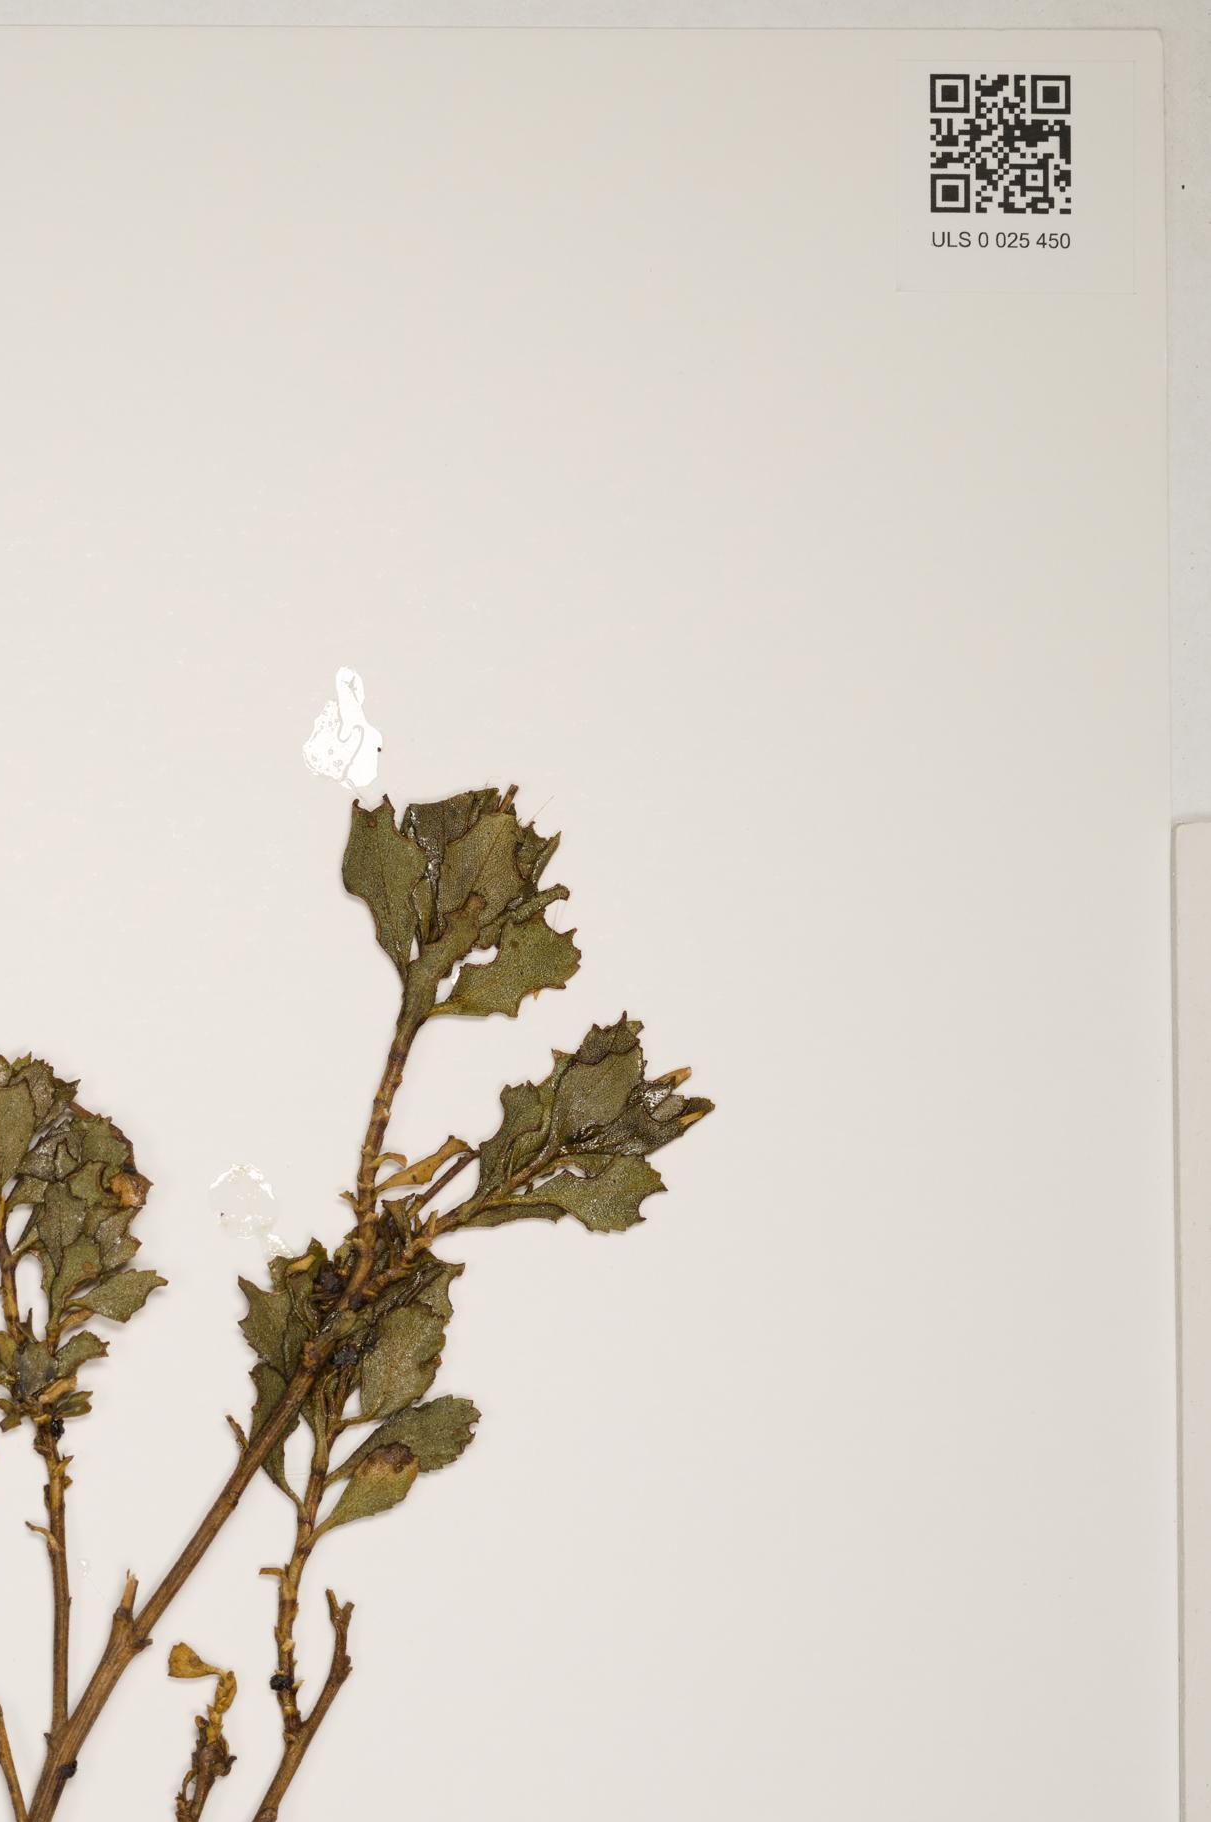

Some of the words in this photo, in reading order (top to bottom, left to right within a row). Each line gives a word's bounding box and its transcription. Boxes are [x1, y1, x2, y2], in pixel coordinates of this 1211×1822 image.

[932, 231, 972, 248] ULS
[977, 231, 989, 249] 0
[995, 231, 1031, 249] 025
[1035, 232, 1071, 250] 450
